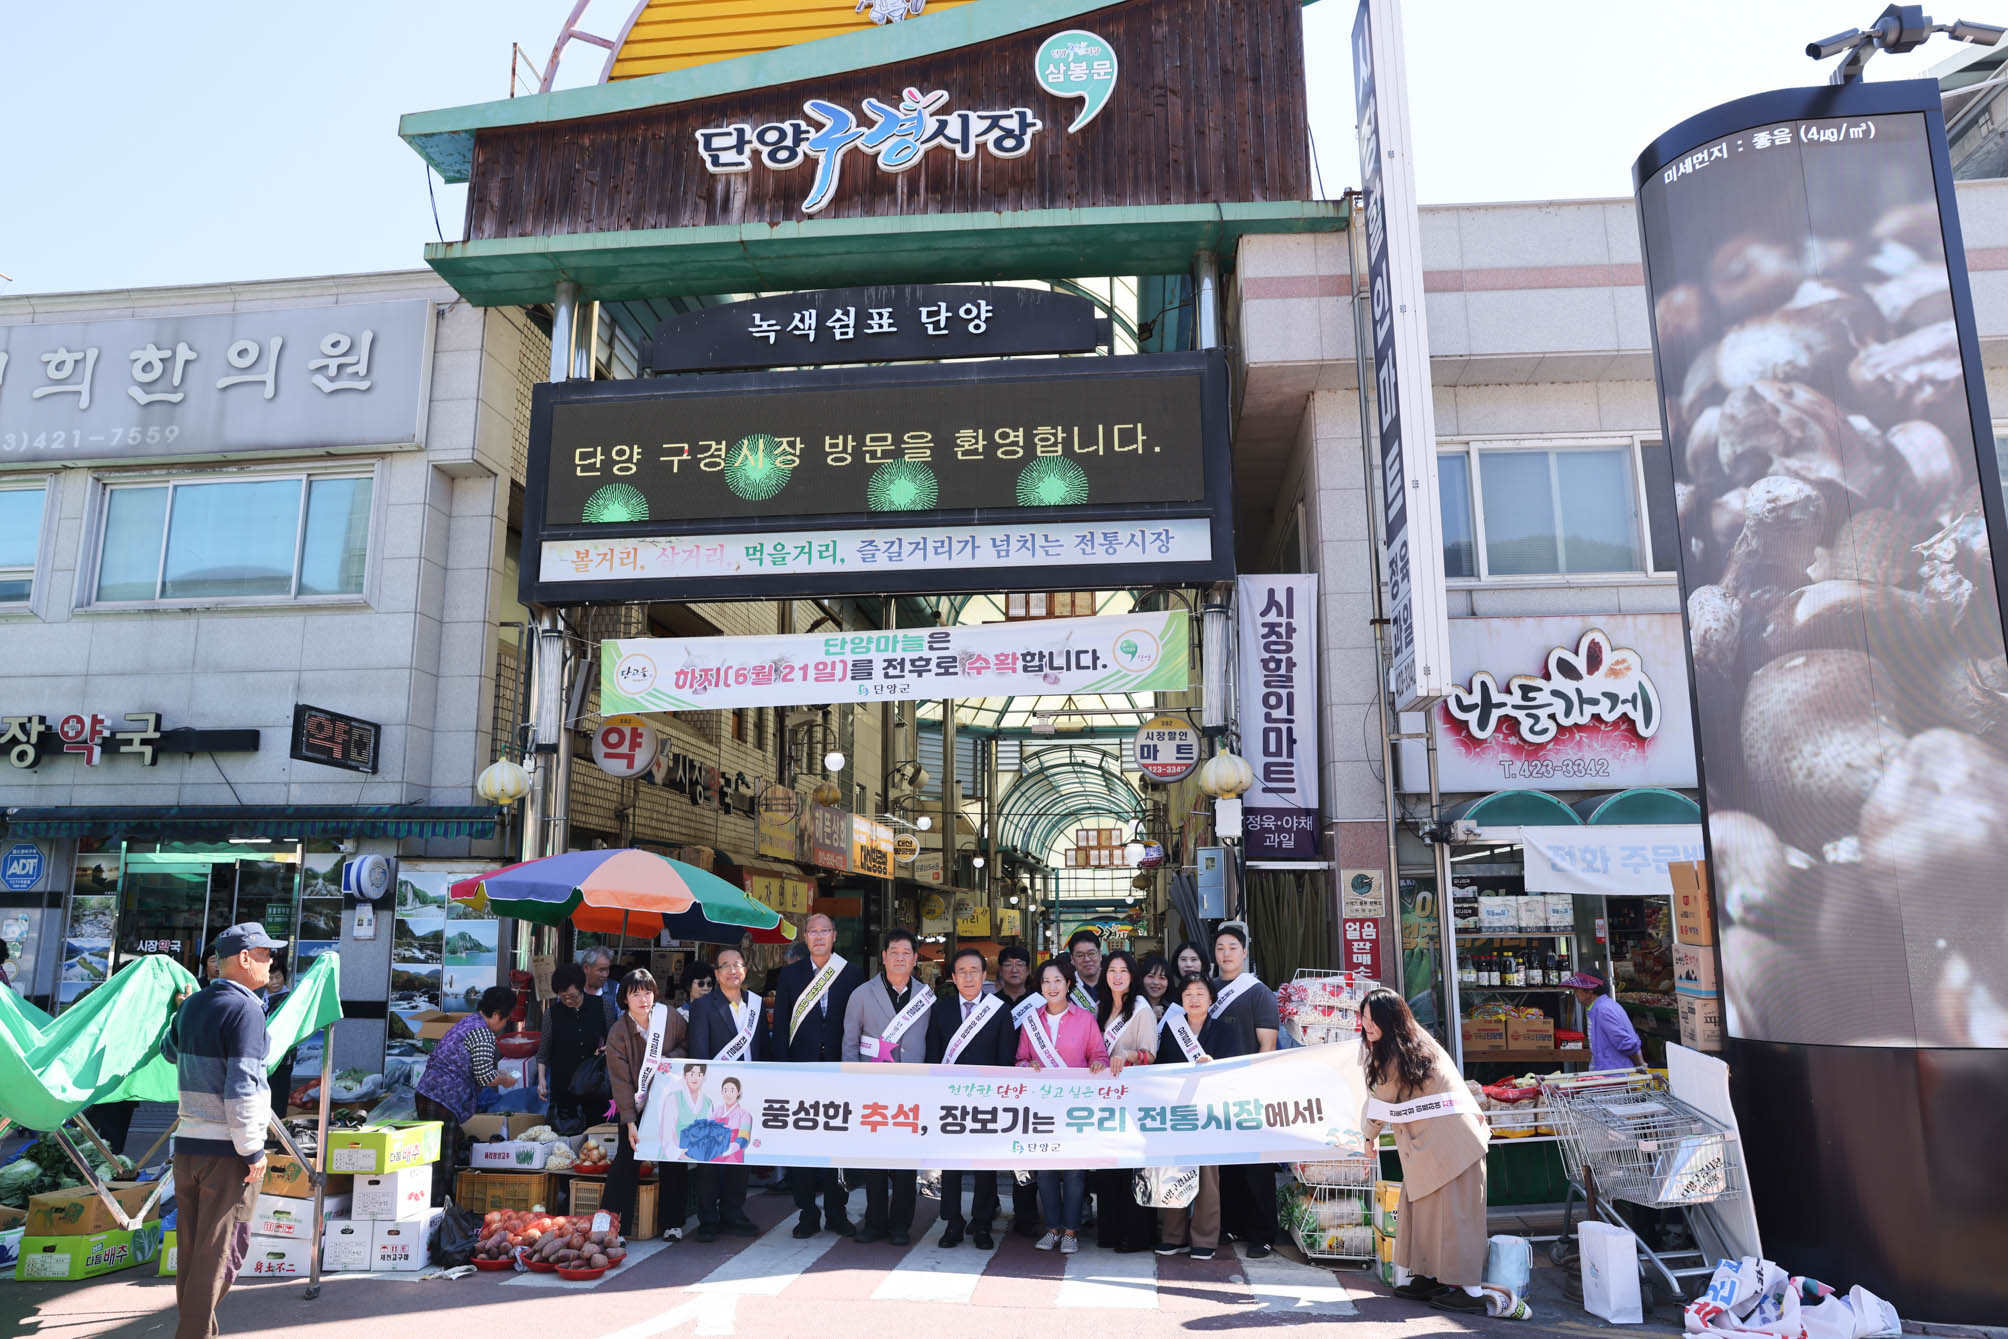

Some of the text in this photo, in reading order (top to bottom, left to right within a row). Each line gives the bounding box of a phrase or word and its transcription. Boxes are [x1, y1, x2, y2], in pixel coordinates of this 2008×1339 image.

[1045, 61, 1113, 83] 삼봉문
[698, 92, 1038, 210] 단양구경시장
[1664, 142, 1728, 184] 미세먼지
[1752, 127, 1792, 150] 좋음
[748, 300, 993, 344] 녹색쉼표 단양
[574, 422, 1161, 477] 단양 구경시장 방문을 환영합니다.
[571, 546, 645, 573] 볼거리,
[743, 539, 846, 567] 먹을거리,
[856, 535, 981, 564] 즐길거리가
[990, 533, 1065, 558] 넘치는
[1073, 528, 1175, 556] 전통시장
[824, 631, 951, 656] 단양마늘은
[882, 655, 958, 680] 전후로
[966, 648, 1108, 675] 수확합니다.
[874, 683, 911, 695] 단양군
[1259, 586, 1297, 794] 시장할인마트
[1451, 676, 1656, 738] 나들가게
[601, 726, 643, 769] 약
[1145, 731, 1188, 741] 시장할인
[1263, 832, 1296, 848] 과일
[8, 858, 37, 875] ADT
[1547, 844, 1611, 874] 전화
[137, 940, 182, 953] 시장약국
[1352, 941, 1372, 976] 판매소
[997, 1083, 1027, 1100] 단양
[1098, 1083, 1130, 1101] 단양
[761, 1098, 1325, 1137] 풍성한 추석, 장보기는 우리 전통시장에서!
[1027, 1142, 1061, 1153] 단양군
[254, 1260, 296, 1274] 身土不二
